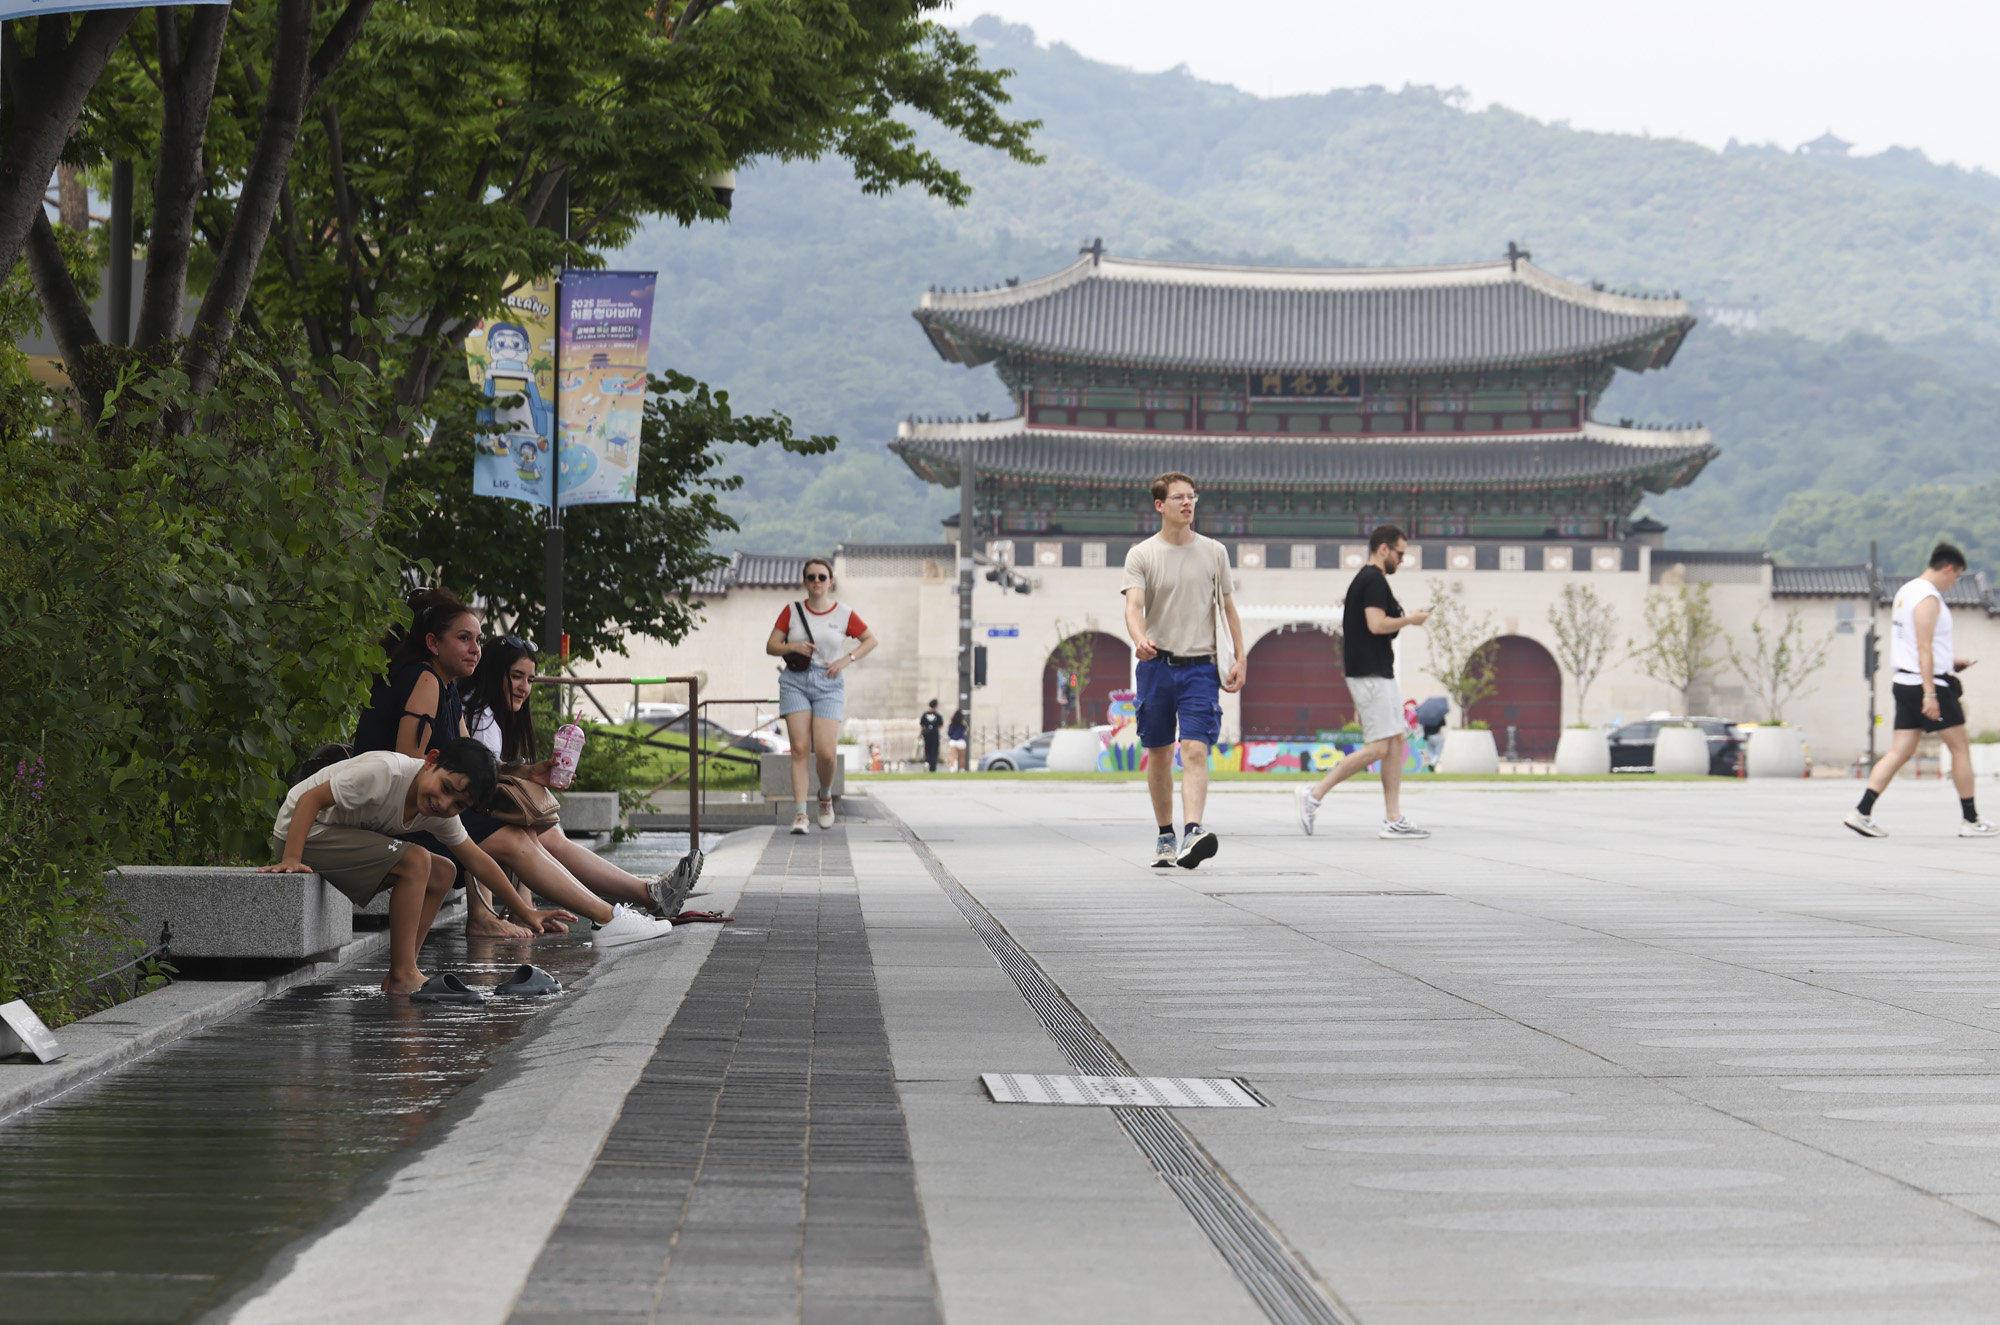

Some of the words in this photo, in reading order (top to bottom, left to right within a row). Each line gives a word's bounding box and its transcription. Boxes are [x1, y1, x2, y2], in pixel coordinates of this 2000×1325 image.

[501, 295, 550, 316] RLAND
[571, 298, 595, 309] 2025
[493, 480, 510, 489] LIG
